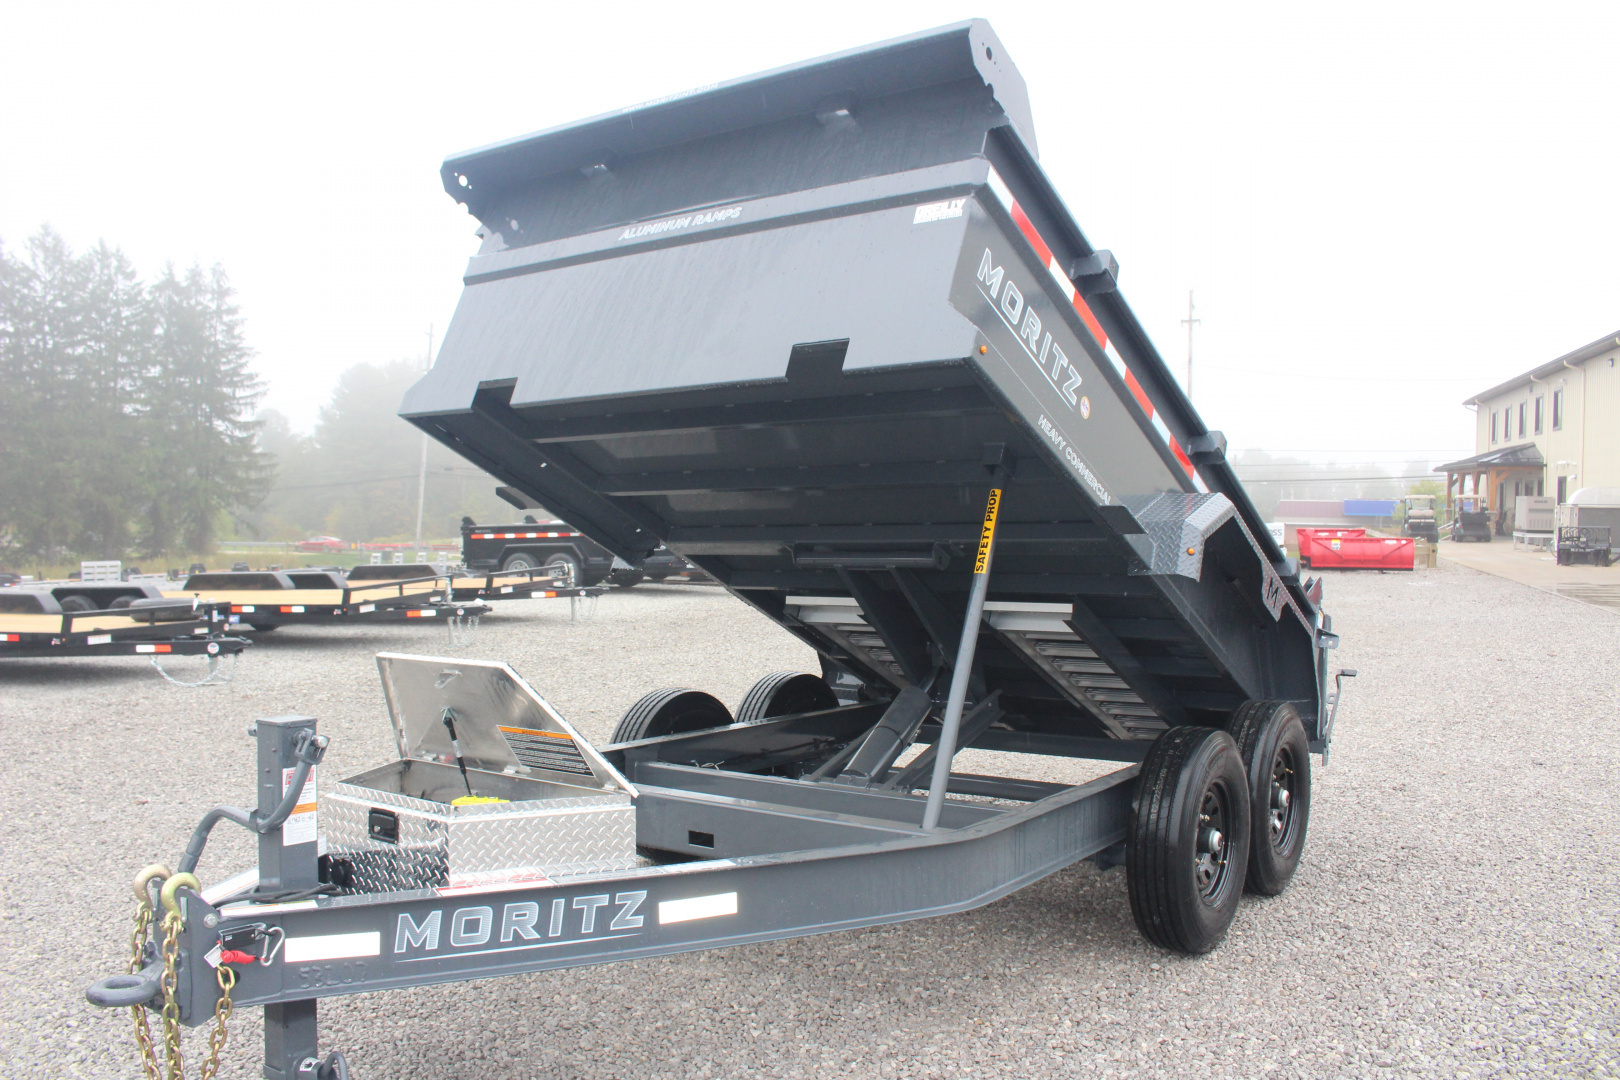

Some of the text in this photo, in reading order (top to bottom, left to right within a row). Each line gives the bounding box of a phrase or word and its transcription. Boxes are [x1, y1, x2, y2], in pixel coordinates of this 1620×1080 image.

[618, 206, 743, 241] ALUMINUM RAMPS
[976, 247, 1084, 407] MORITZ
[1037, 414, 1067, 450] HEAVY
[975, 490, 998, 572] SAFETY PROP
[394, 889, 648, 954] MORITZ
